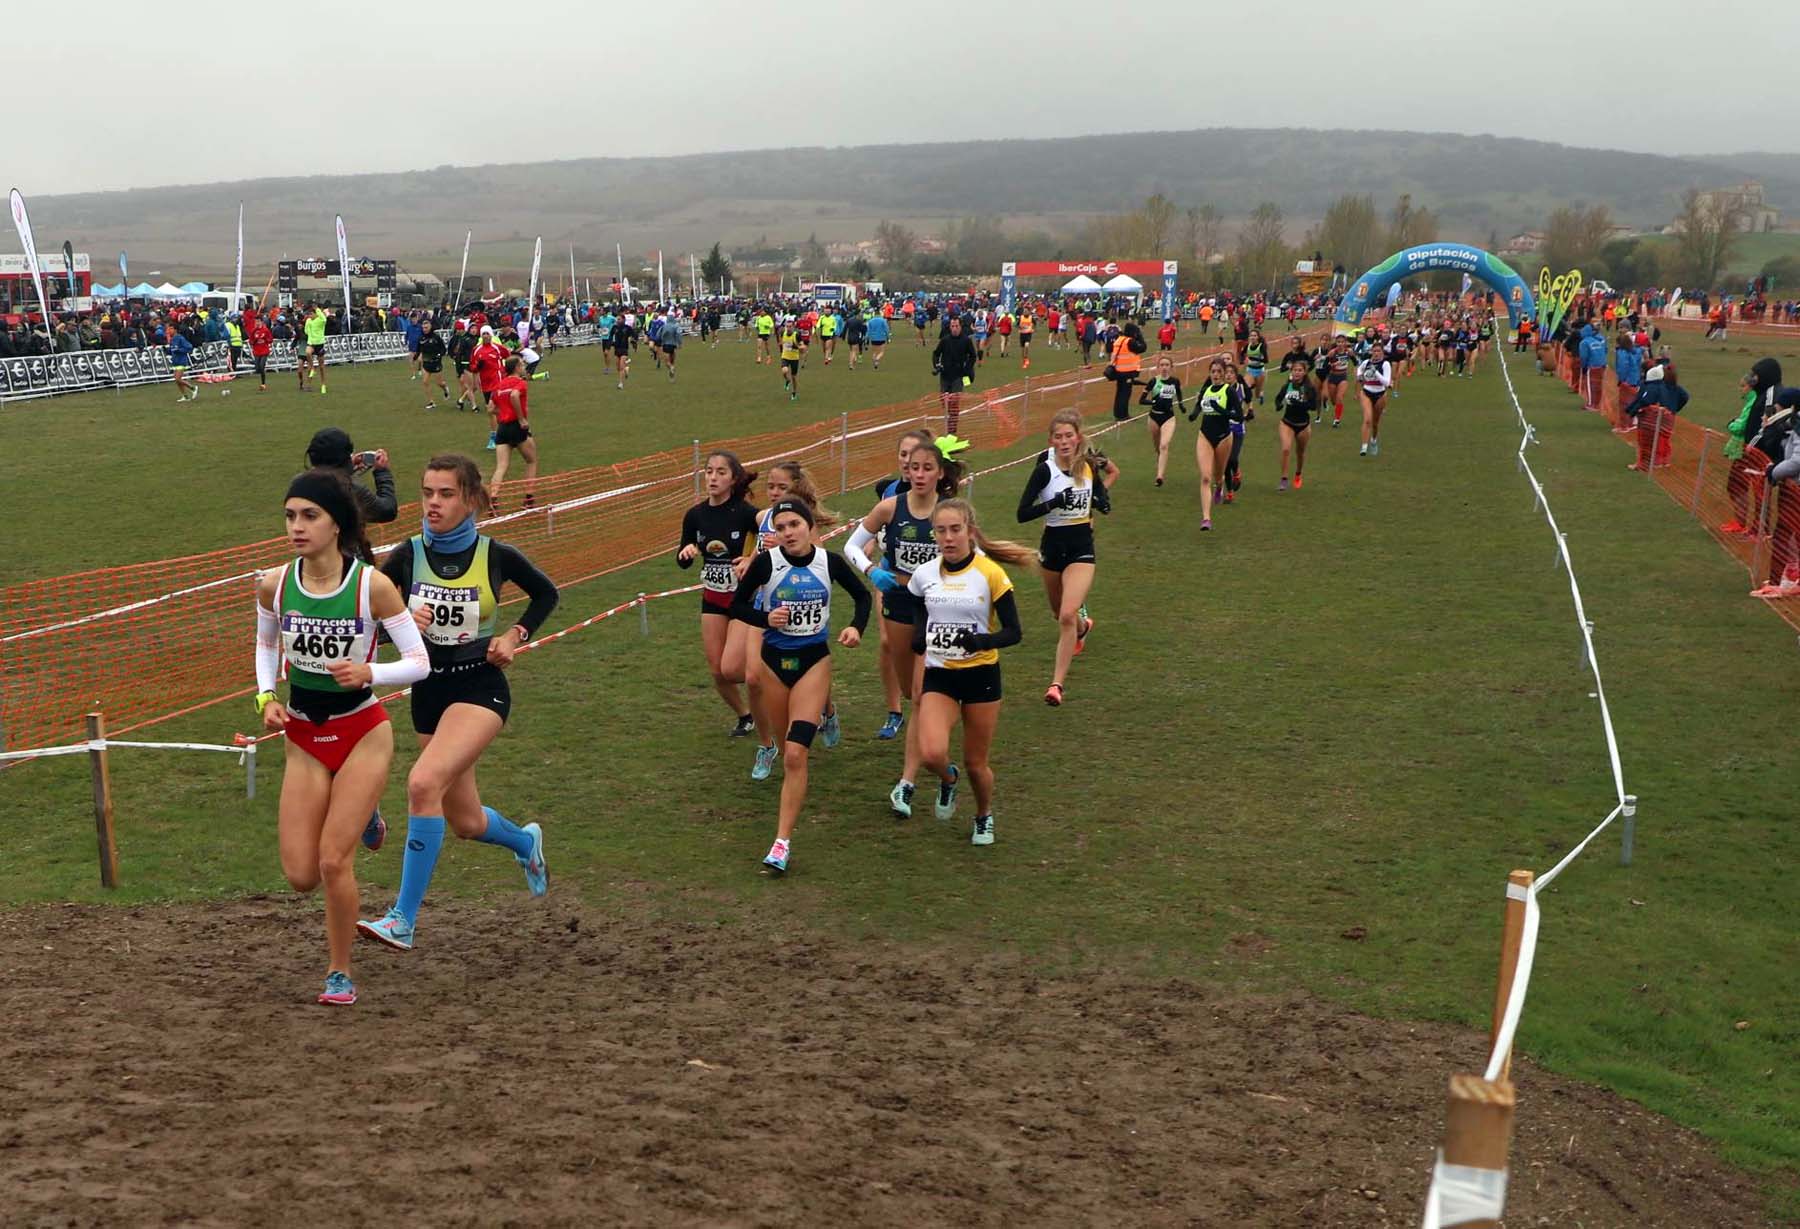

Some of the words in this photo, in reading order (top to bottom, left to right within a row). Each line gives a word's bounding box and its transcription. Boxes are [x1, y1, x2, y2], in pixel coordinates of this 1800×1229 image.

[1407, 248, 1479, 262] Diputación
[297, 260, 327, 273] Burgos
[1409, 261, 1425, 271] de
[1429, 258, 1477, 271] Burgos
[704, 571, 732, 585] 4681
[418, 590, 472, 601] BURGOS
[419, 584, 471, 595] DIPUTACIÓN
[788, 603, 823, 611] URGOS
[290, 617, 356, 627] DIPUTACIÓN
[290, 625, 357, 634] BURGOS
[293, 634, 355, 659] 4667
[294, 656, 325, 672] iberCaj
